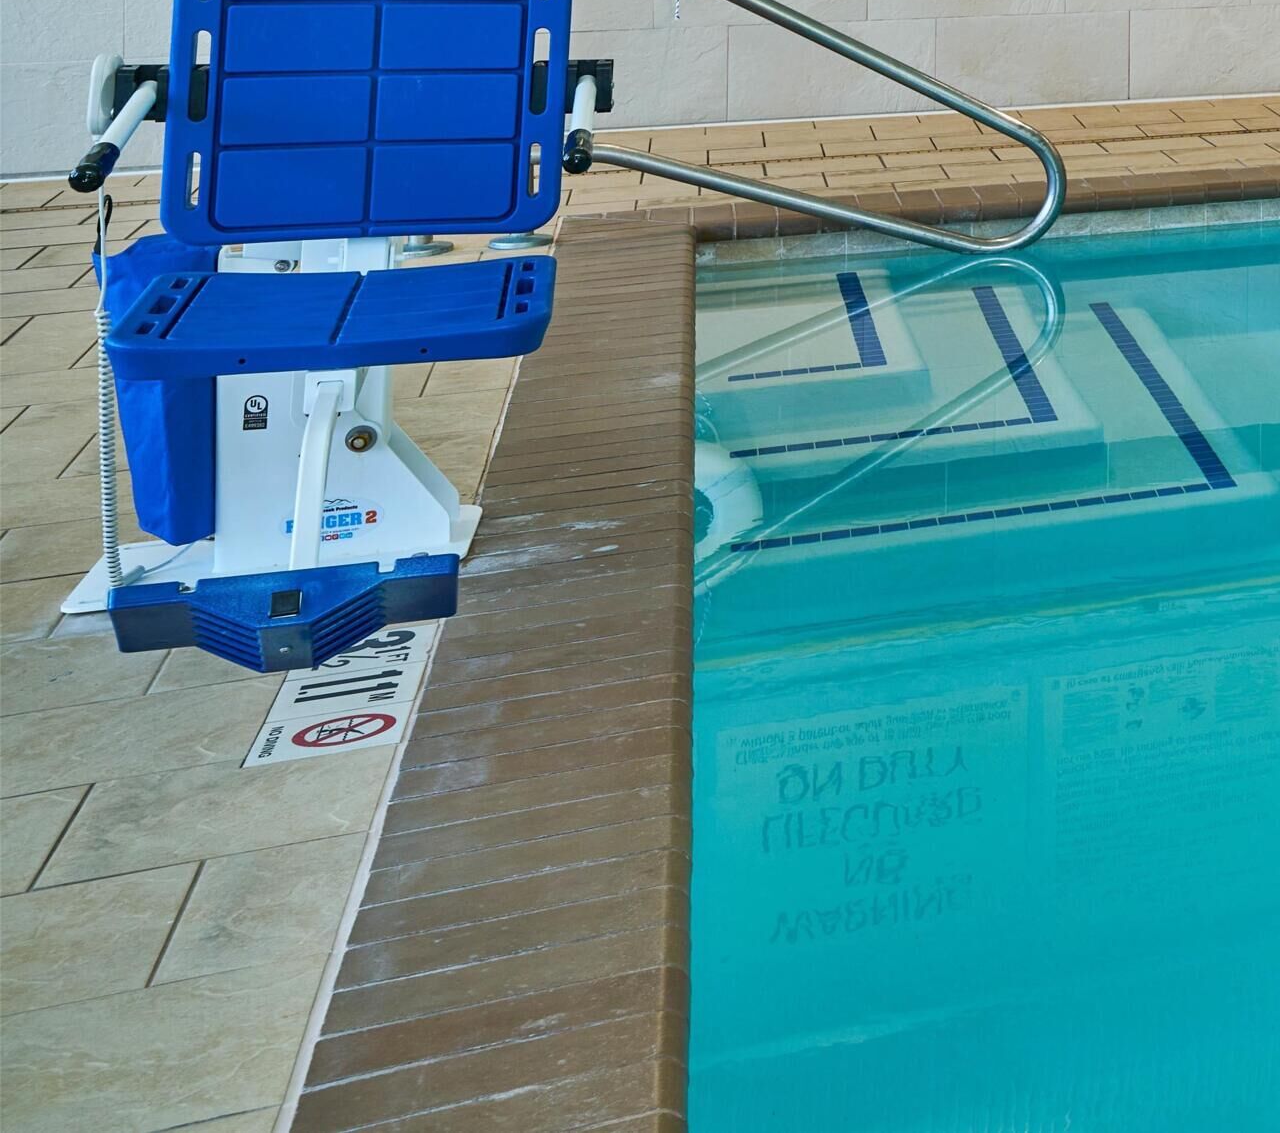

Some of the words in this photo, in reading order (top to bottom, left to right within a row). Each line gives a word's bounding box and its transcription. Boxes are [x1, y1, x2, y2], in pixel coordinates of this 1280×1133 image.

[365, 510, 377, 524] 2
[270, 725, 285, 736] NO
[258, 736, 280, 759] DIVING
